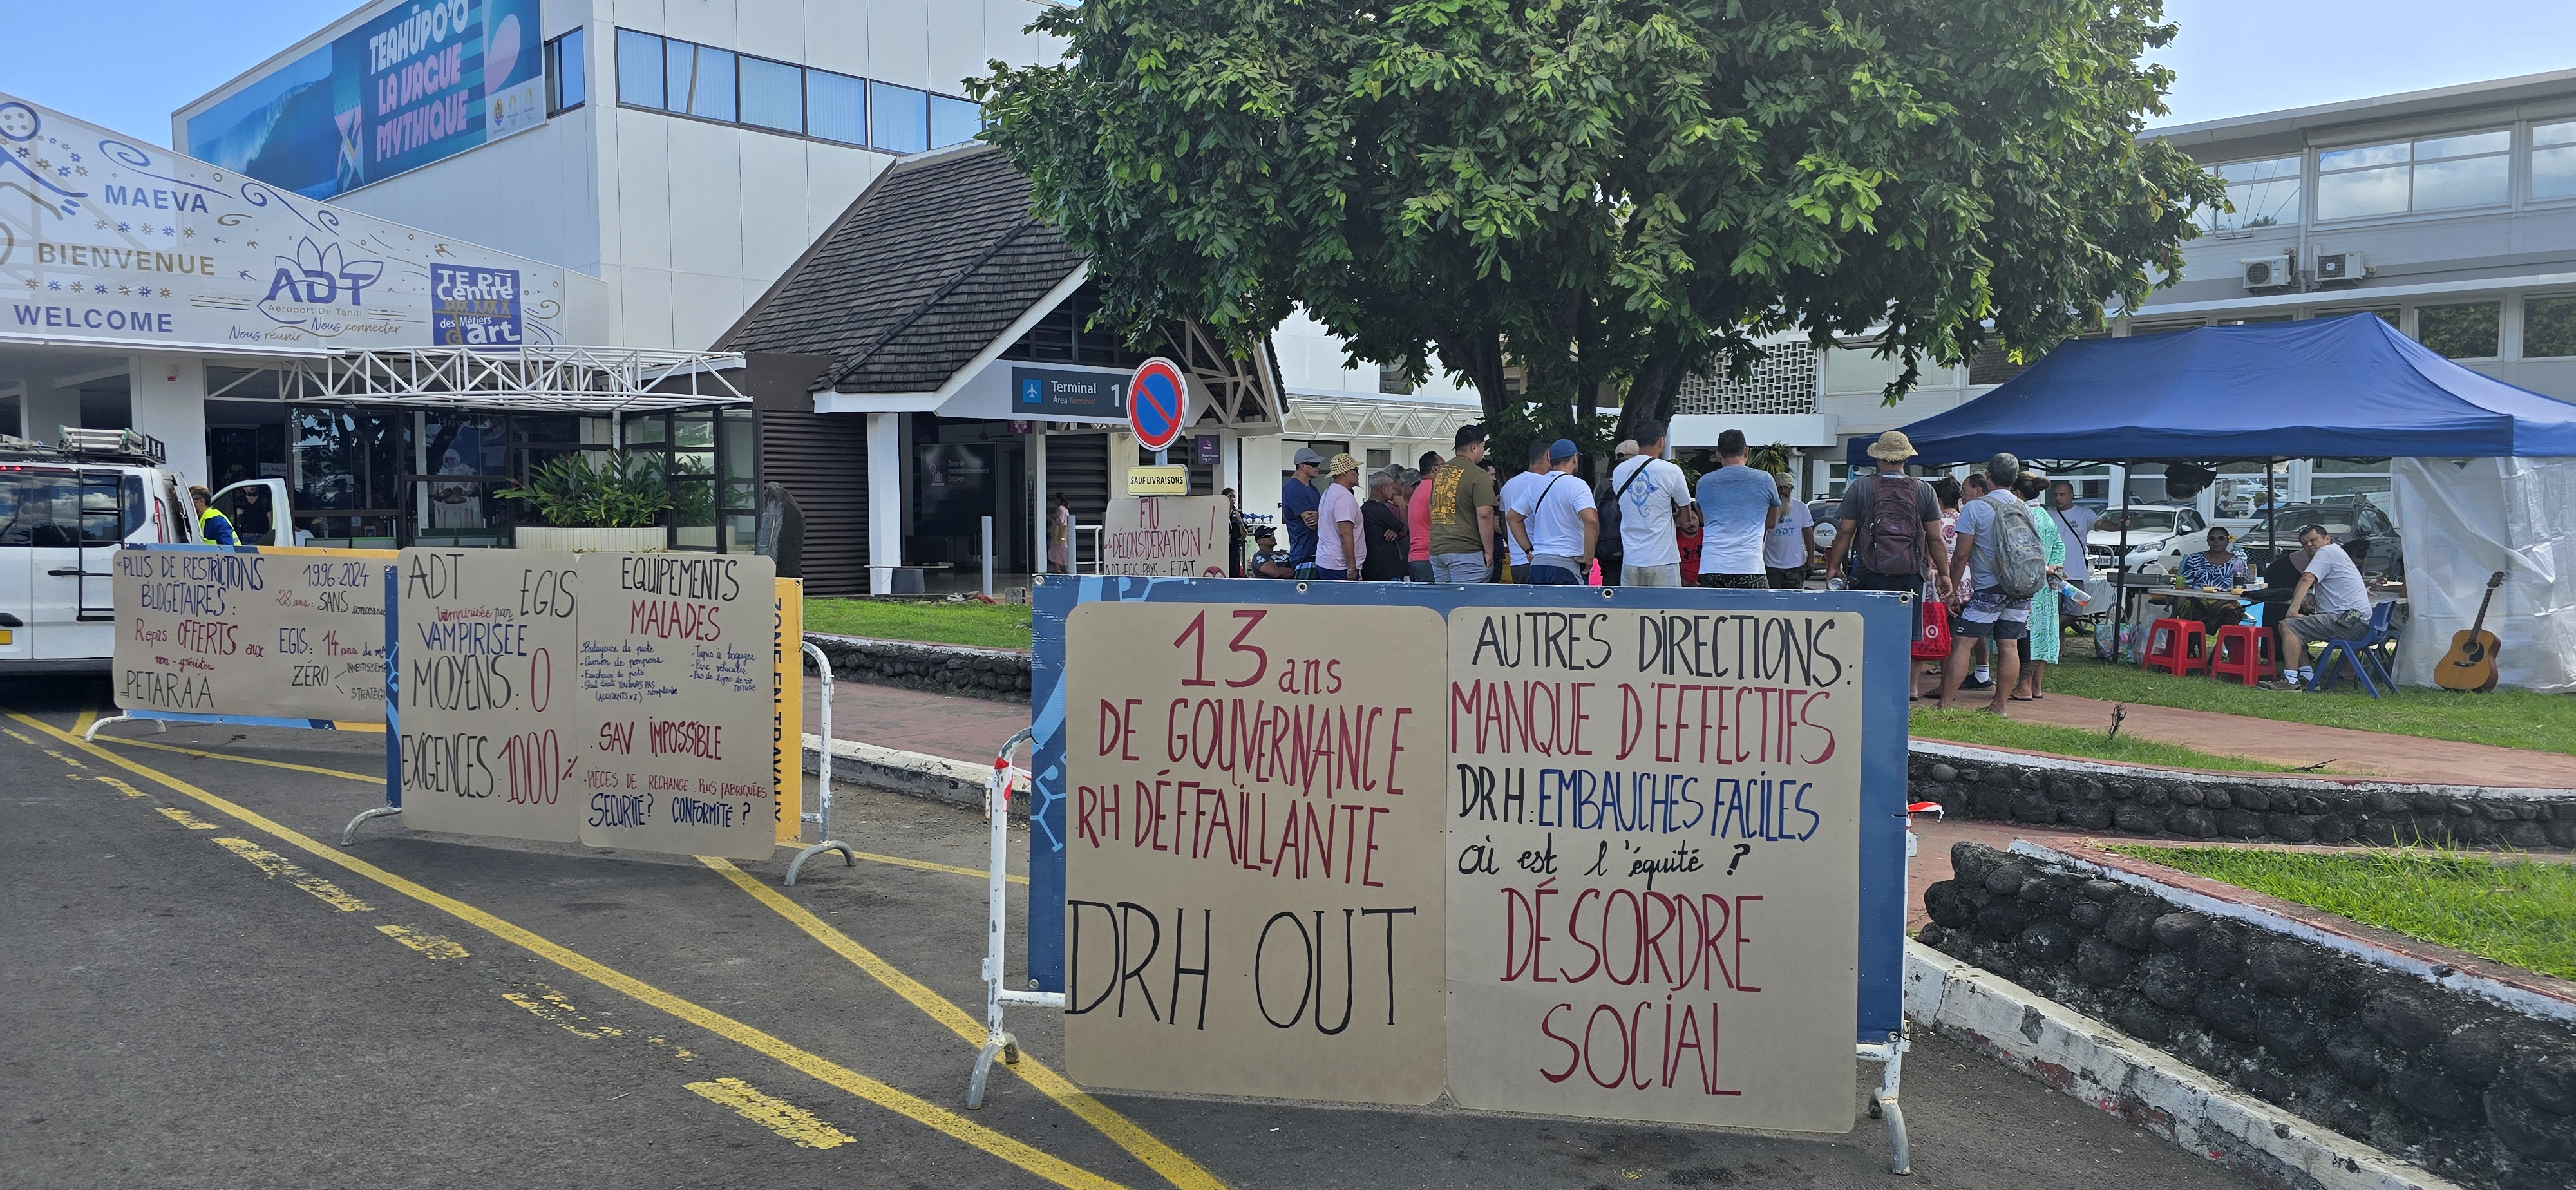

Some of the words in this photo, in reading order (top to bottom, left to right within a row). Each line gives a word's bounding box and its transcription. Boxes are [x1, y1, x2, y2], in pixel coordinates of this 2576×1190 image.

[378, 73, 397, 117] LA
[401, 42, 462, 108] VAGUE
[376, 89, 468, 162] MYTHIQUE
[105, 184, 209, 214] MAEVA
[39, 242, 215, 276] BIENVENUE
[267, 268, 376, 306] ADT
[437, 269, 469, 288] TE
[437, 283, 513, 301] Centre
[14, 303, 173, 333] WELCOME
[268, 304, 314, 314] Aéroport
[440, 318, 455, 328] des
[459, 316, 491, 326] Métiers
[229, 325, 261, 341] Nous
[311, 317, 341, 333] Nous
[345, 322, 401, 334] connecter
[1050, 380, 1097, 394] Terminal
[1110, 384, 1120, 407] 1
[438, 417, 464, 426] HEIV
[1147, 476, 1184, 484] LIVRAISONS
[1140, 497, 1159, 529] FIU
[1113, 525, 1201, 560] DÉCONSIDÉRATION
[1208, 505, 1215, 550] !
[162, 555, 176, 578] DE
[184, 554, 264, 590] RESTRICTIONS
[303, 562, 370, 587] 1996-2024
[408, 553, 464, 600] ADT
[621, 554, 739, 601] EQUIPEMENTS
[1105, 563, 1119, 575] ADT
[1171, 560, 1195, 577] ETAT
[142, 581, 226, 616] BUDGÉTAIRES
[276, 590, 292, 607] 28
[317, 590, 348, 612] SANS
[520, 569, 577, 618] EGIS
[436, 606, 492, 628] vampirisée
[494, 607, 513, 623] par
[630, 600, 721, 641] MALADES
[135, 619, 167, 644] Repas
[178, 620, 238, 655] OFFERTS
[245, 645, 264, 657] aux
[322, 630, 339, 656] 14
[341, 647, 358, 656] ans
[363, 641, 372, 656] de
[417, 619, 527, 657] VAMPIRISÉE
[622, 639, 632, 652] de
[636, 641, 654, 655] piste
[1173, 609, 1268, 688] 13
[1278, 658, 1343, 695] ans
[1472, 612, 1611, 670] AUTRES
[614, 657, 625, 666] de
[629, 657, 663, 668] pompiers
[715, 661, 748, 675] véhicules
[716, 648, 722, 659] à
[727, 643, 757, 666] bagages
[292, 660, 329, 686] ZÉRO
[531, 648, 550, 712] 0
[617, 680, 643, 690] TOUJOURS
[645, 681, 655, 689] PAS
[628, 667, 645, 681] piste
[705, 672, 713, 680] de
[715, 674, 734, 687] ligne
[1452, 679, 1595, 757] MANQUE
[1616, 681, 1835, 765] D'EFFECTIFS
[599, 721, 634, 755] SAV
[650, 716, 722, 760] IMPOSSIBLE
[1099, 699, 1142, 762] DE
[1168, 698, 1412, 798] GOUVERNANCE
[627, 773, 638, 789] DE
[699, 778, 717, 795] PLUS
[721, 781, 768, 799] FABRIQUÉES
[672, 797, 733, 827] CONFORMITÉ
[1539, 768, 1703, 834] EMBAUCHES
[1711, 771, 1820, 842] FACILES
[1078, 784, 1119, 849] RH
[1135, 769, 1390, 888] DÉFFAILLANTE
[1517, 833, 1558, 874] est
[1500, 877, 1763, 992] DÉSORDRE
[1065, 900, 1211, 1030] DRH
[1255, 905, 1417, 1035] OUT
[1540, 994, 1741, 1096] SOCIAL
